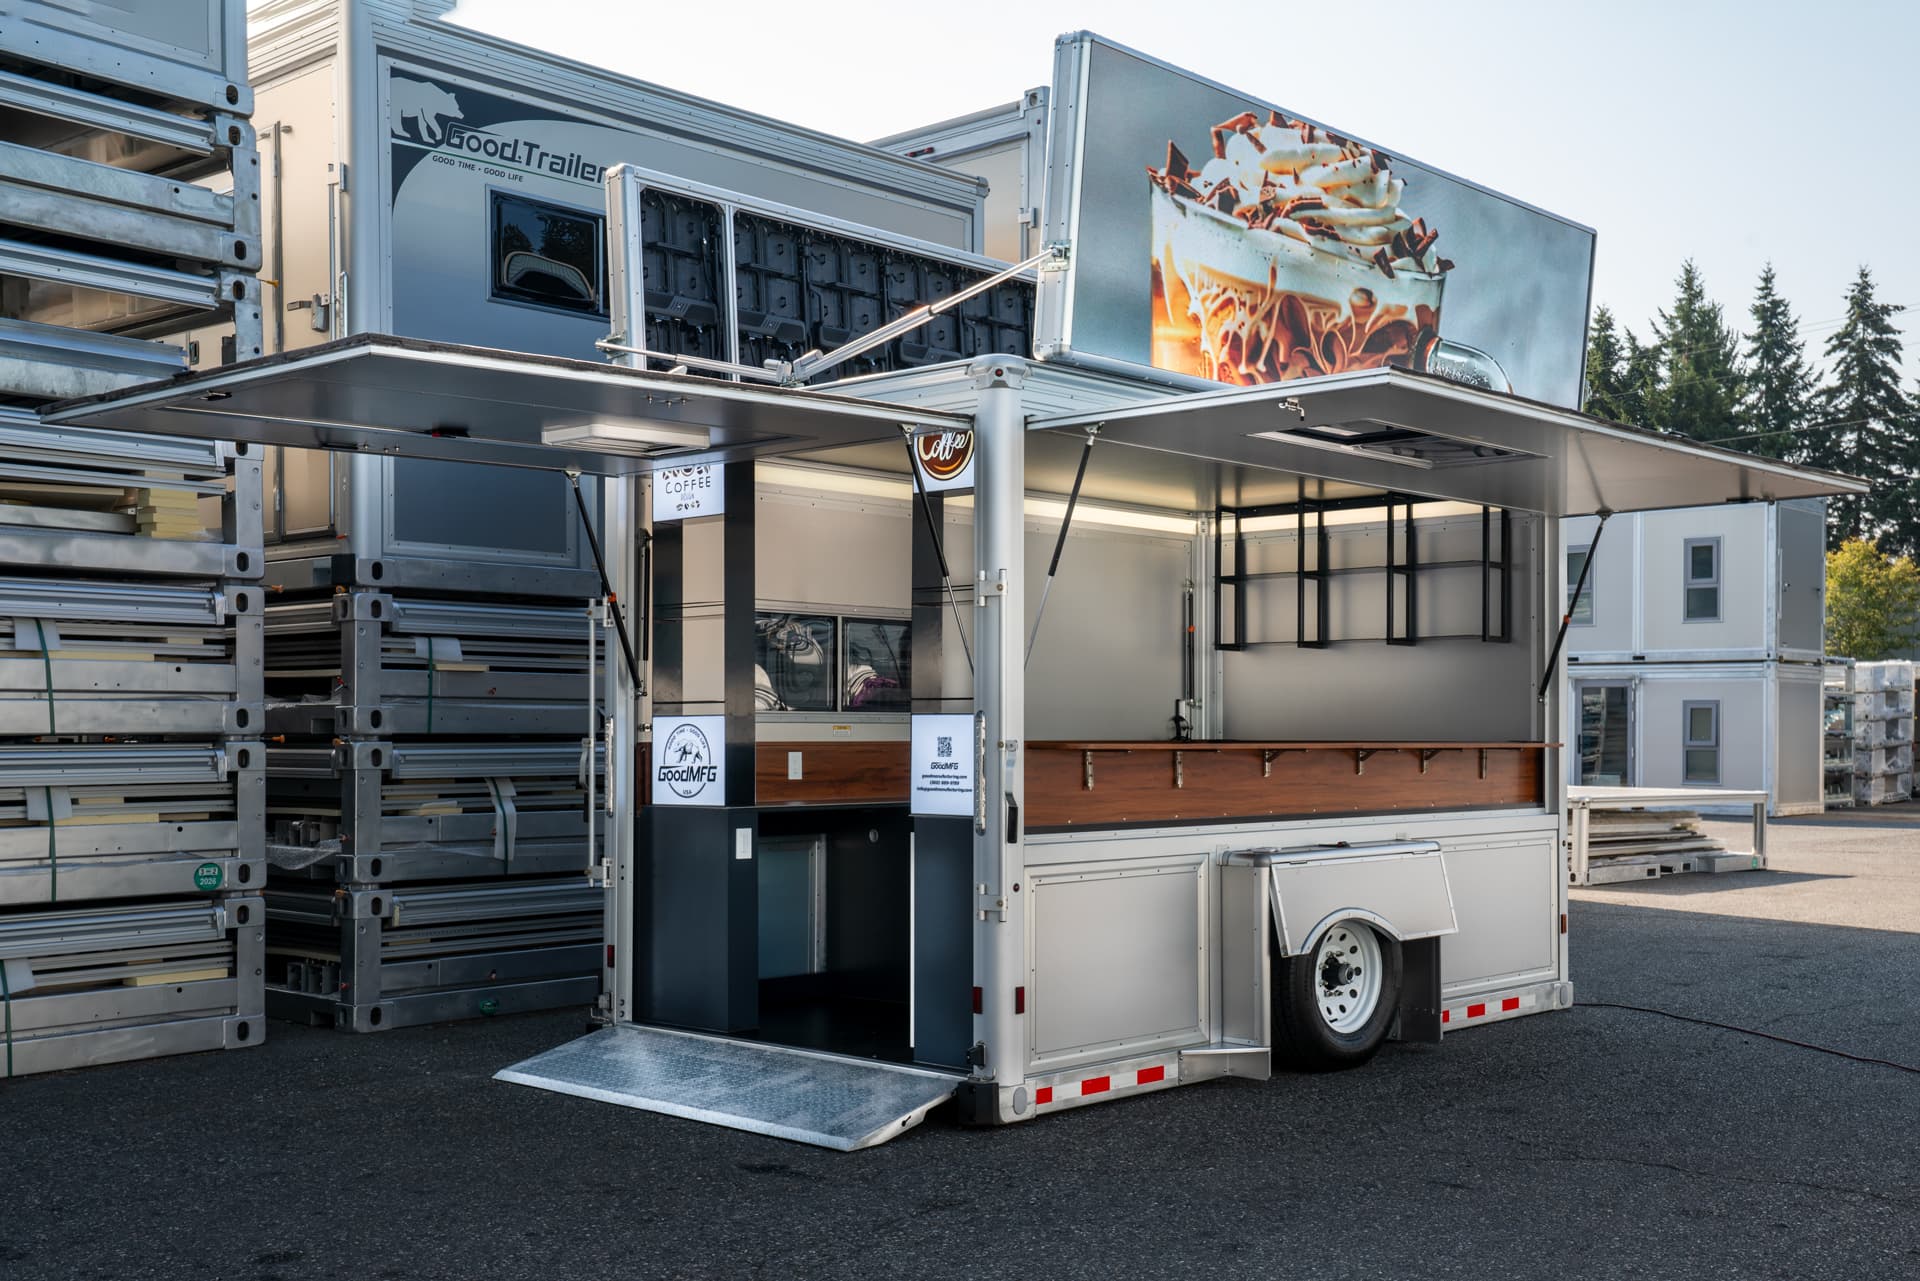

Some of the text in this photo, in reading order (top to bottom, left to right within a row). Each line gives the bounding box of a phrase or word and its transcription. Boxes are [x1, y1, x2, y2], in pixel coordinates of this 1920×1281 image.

[432, 154, 524, 183] GOOD TIME GOOD LIFE
[665, 476, 712, 494] COFFEE
[658, 766, 717, 782] GoodMFG
